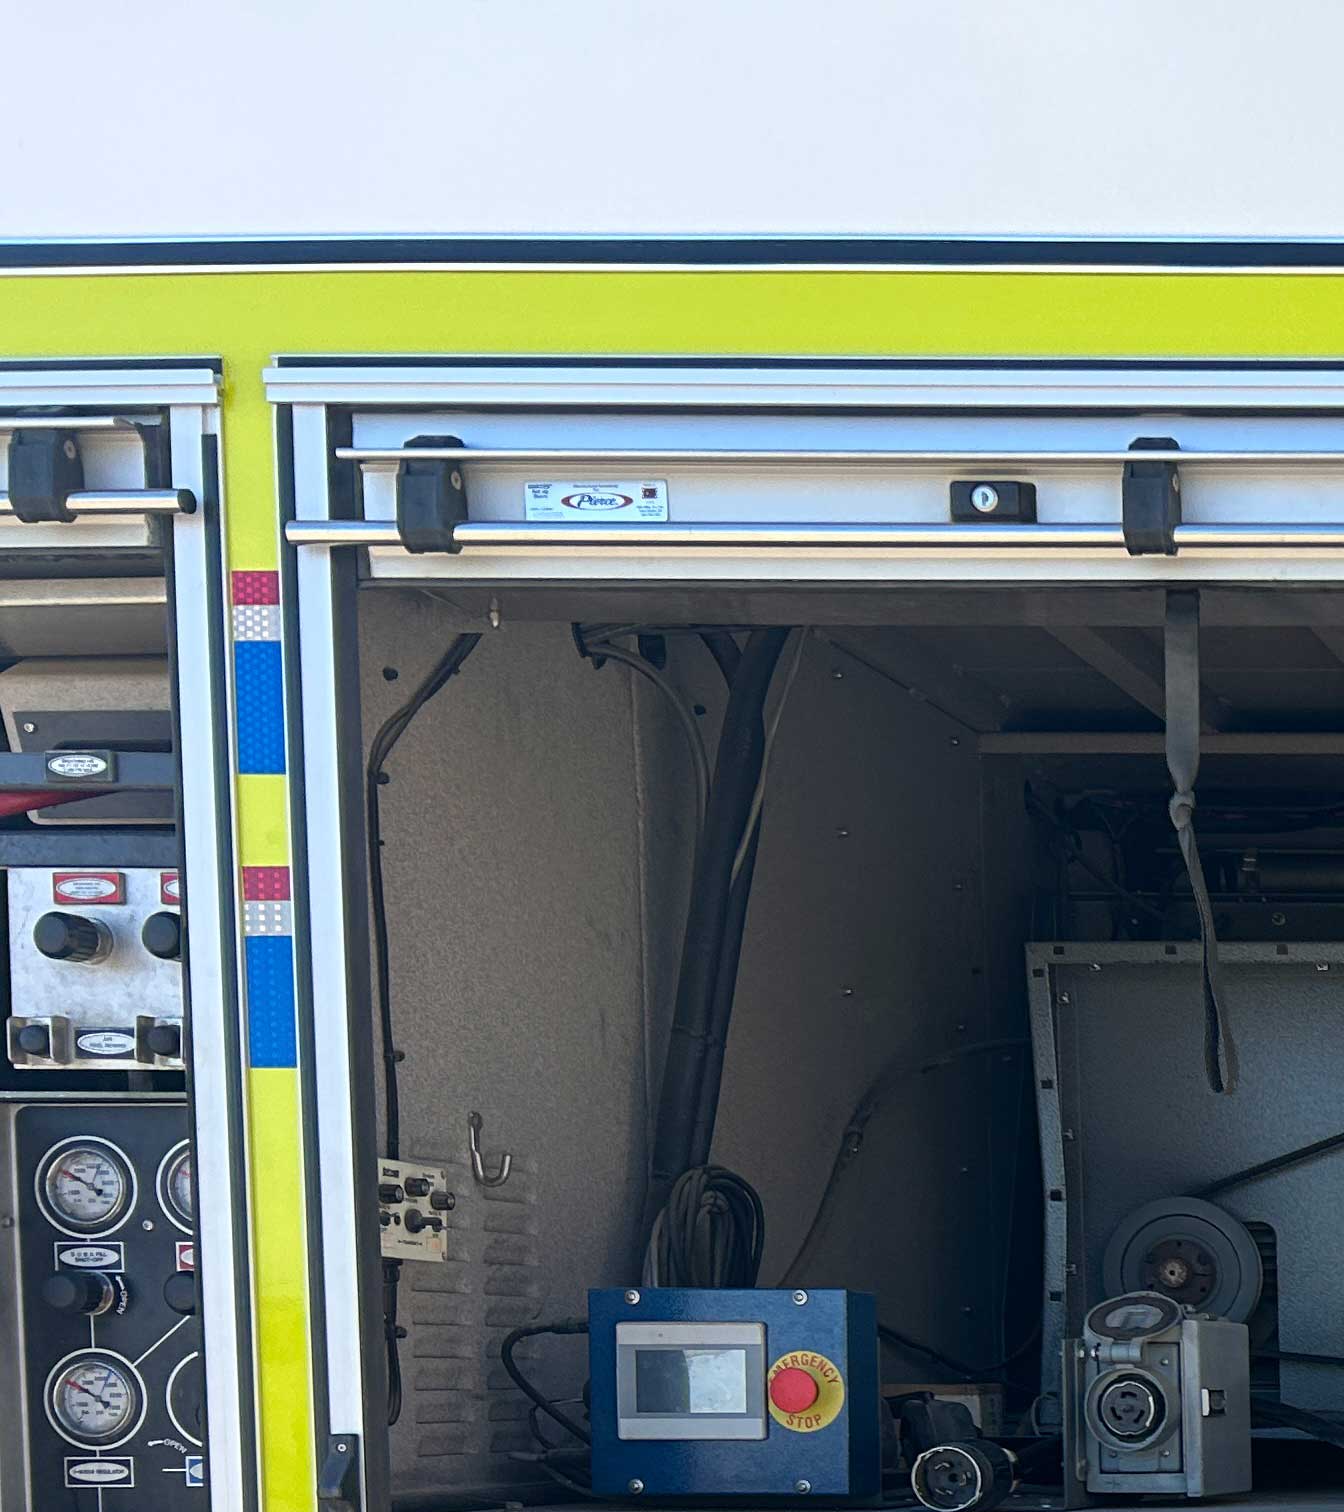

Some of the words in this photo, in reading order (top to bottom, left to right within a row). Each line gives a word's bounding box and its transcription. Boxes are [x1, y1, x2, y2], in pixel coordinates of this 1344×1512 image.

[116, 1291, 127, 1315] OPEN
[770, 1353, 839, 1384] MERGENCY
[786, 1414, 821, 1429] STOP
[163, 1438, 187, 1453] OPEN
